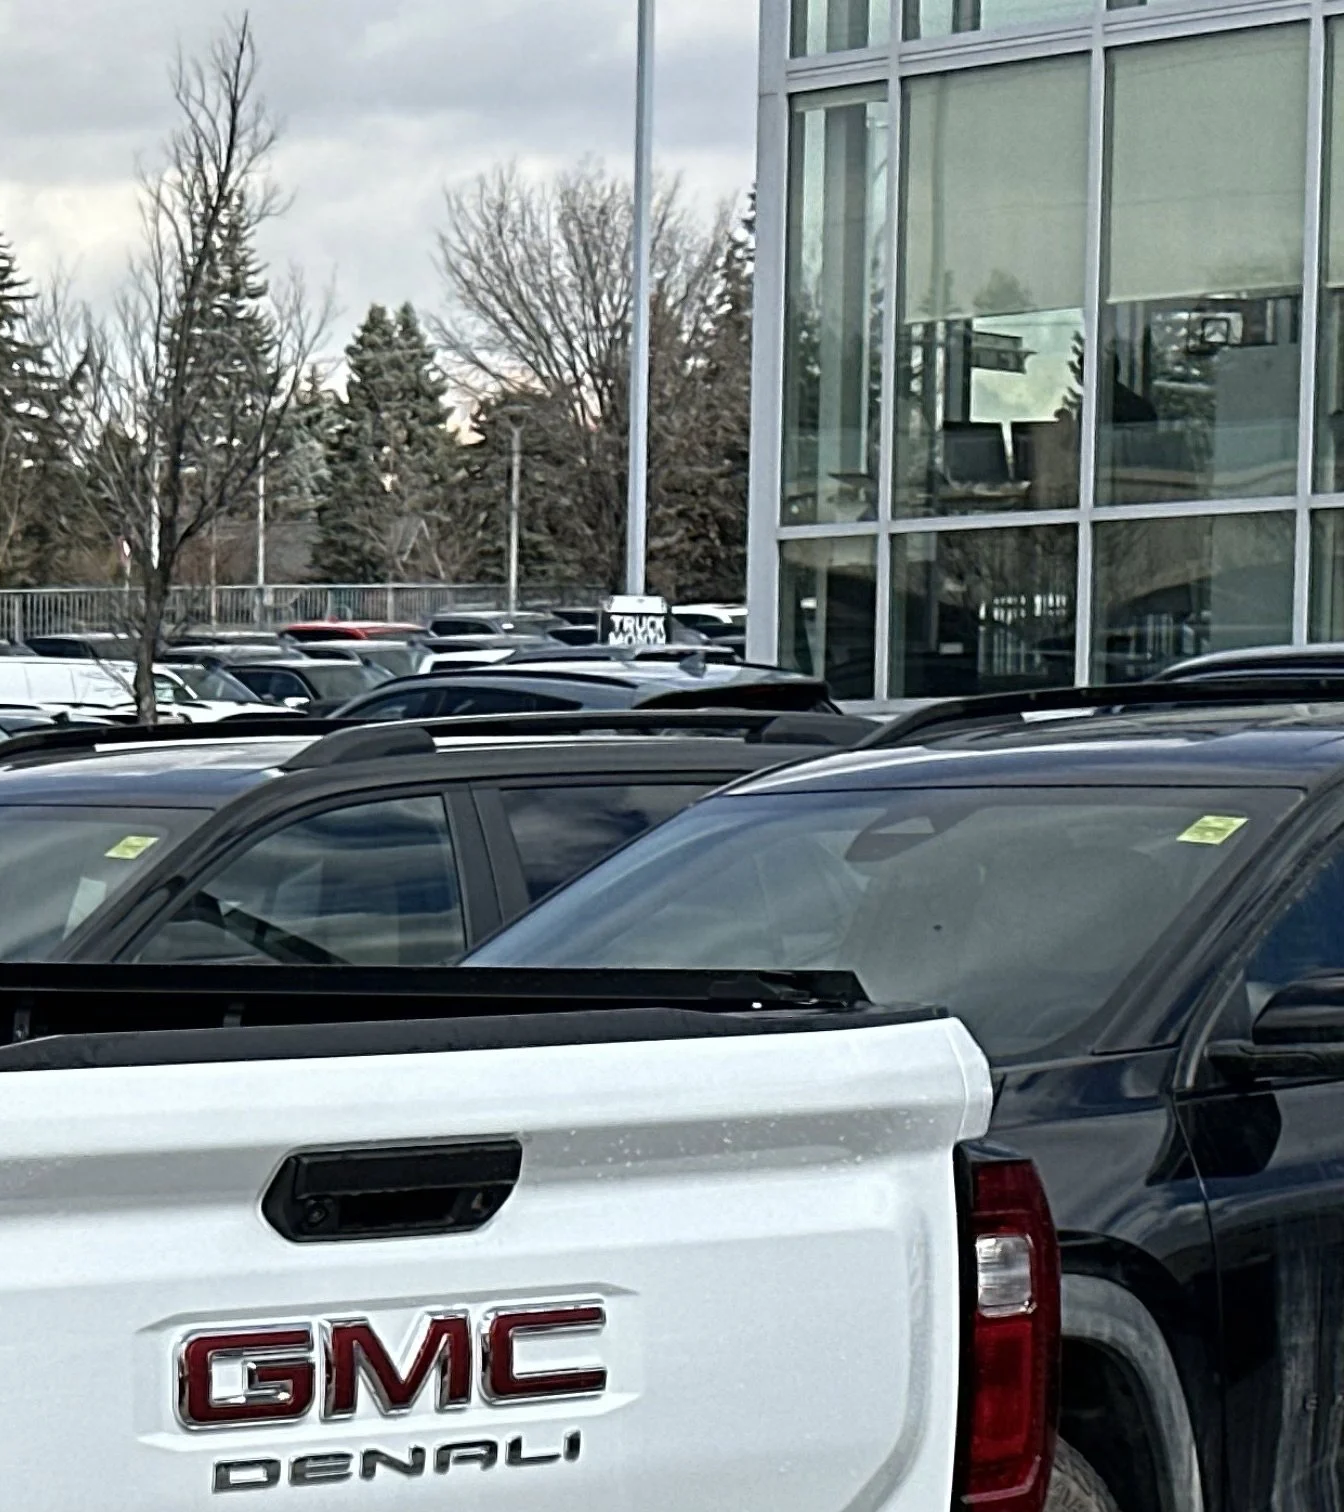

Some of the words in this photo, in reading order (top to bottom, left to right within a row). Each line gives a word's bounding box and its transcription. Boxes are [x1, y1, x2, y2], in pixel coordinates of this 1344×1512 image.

[610, 614, 665, 634] TRUCK
[173, 1292, 609, 1431] GMC
[212, 1429, 582, 1494] DENALI
